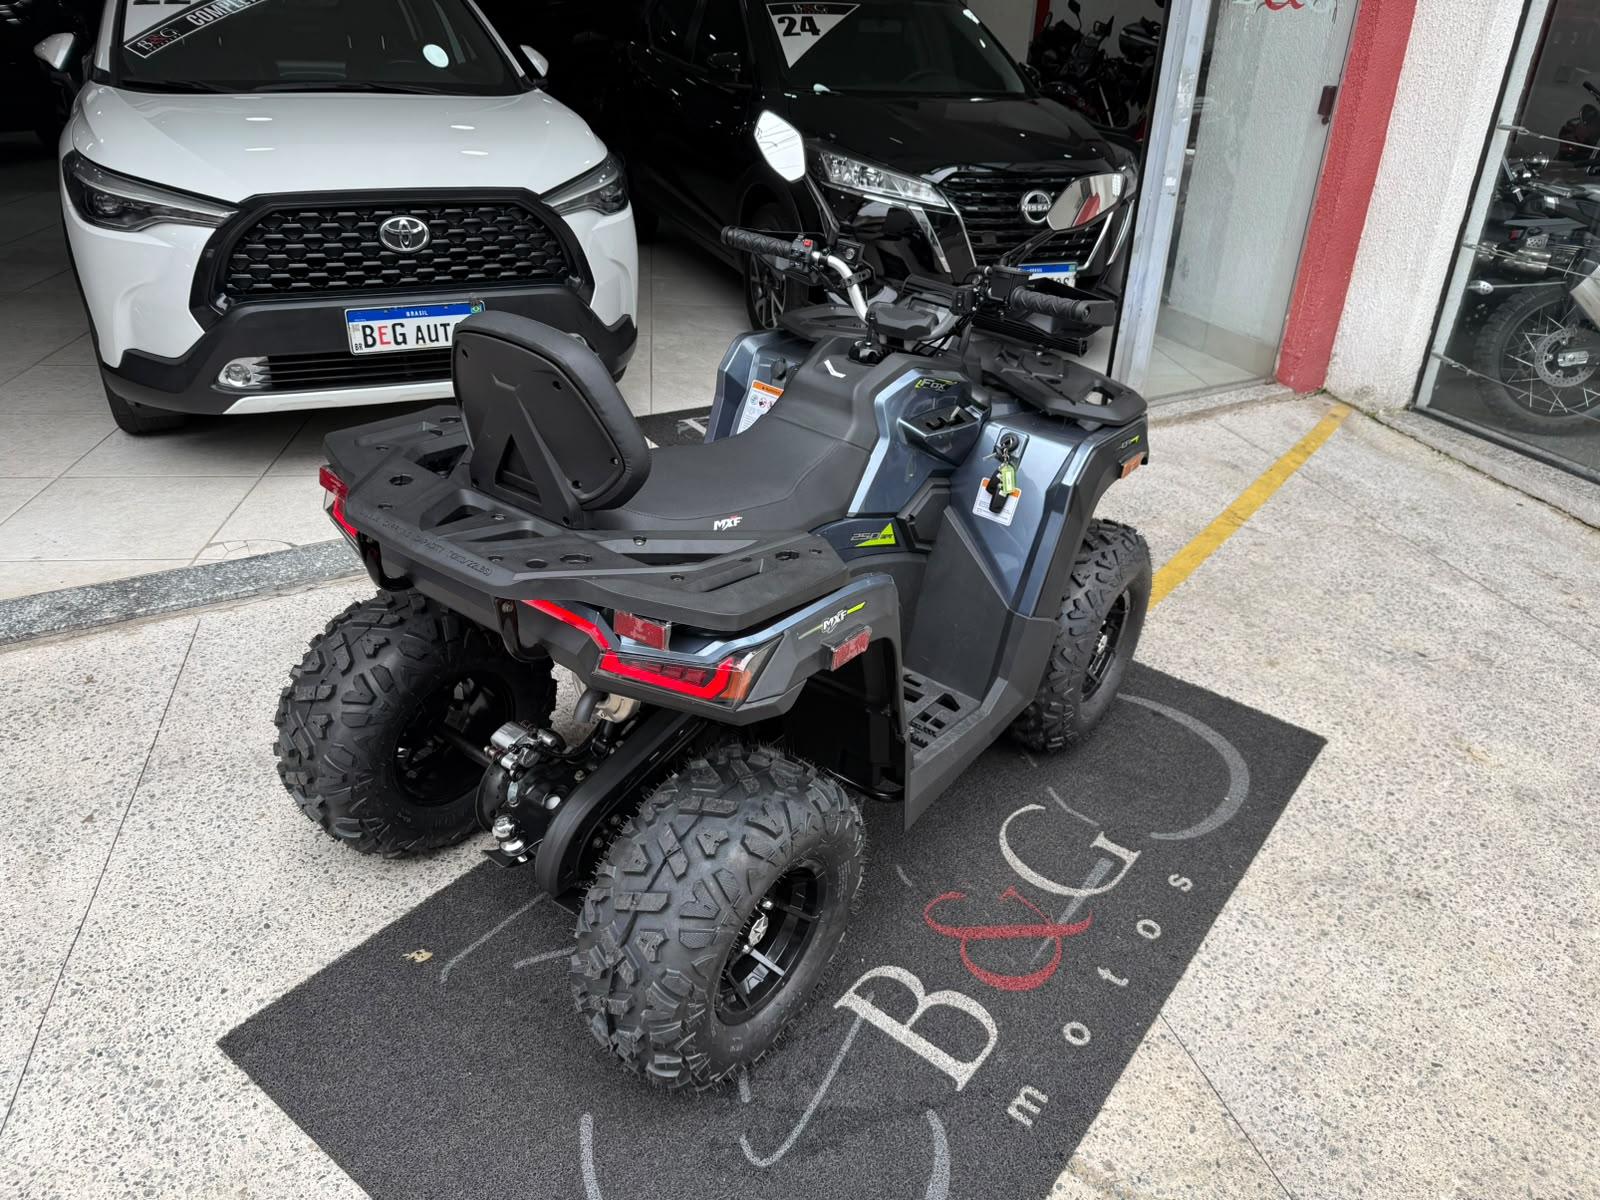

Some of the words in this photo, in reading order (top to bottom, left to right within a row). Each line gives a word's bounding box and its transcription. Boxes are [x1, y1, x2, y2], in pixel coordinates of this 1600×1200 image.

[777, 15, 821, 37] 24
[361, 322, 408, 349] BEG
[415, 322, 451, 345] AUT
[713, 514, 744, 531] MXF
[822, 608, 848, 632] MXF
